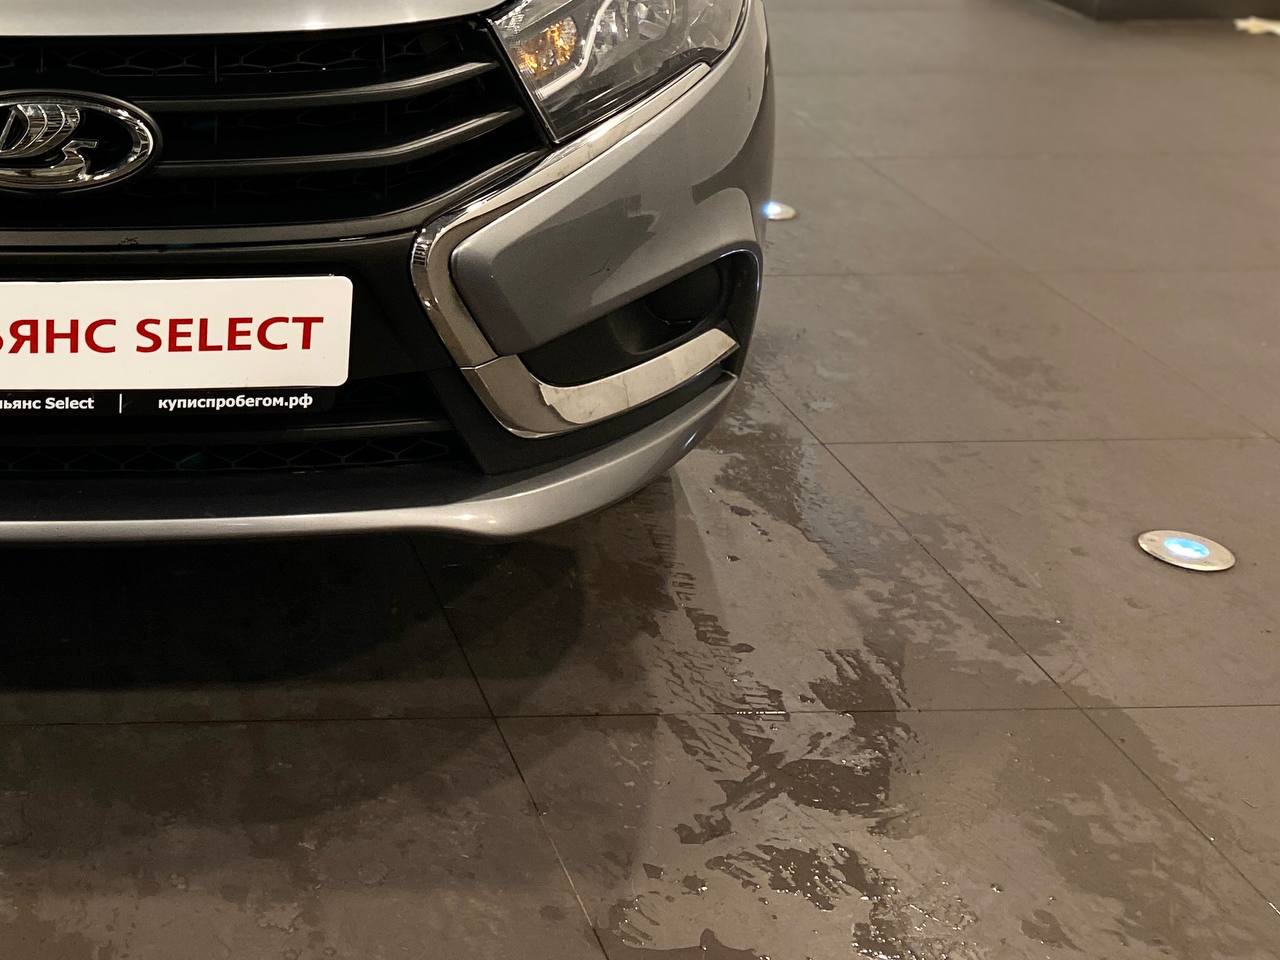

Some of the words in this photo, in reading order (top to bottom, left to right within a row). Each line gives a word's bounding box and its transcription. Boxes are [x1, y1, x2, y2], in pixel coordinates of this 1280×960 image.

[135, 315, 325, 354] SELECT
[44, 396, 95, 410] Select
[158, 393, 313, 412] куписпробегом.рф
